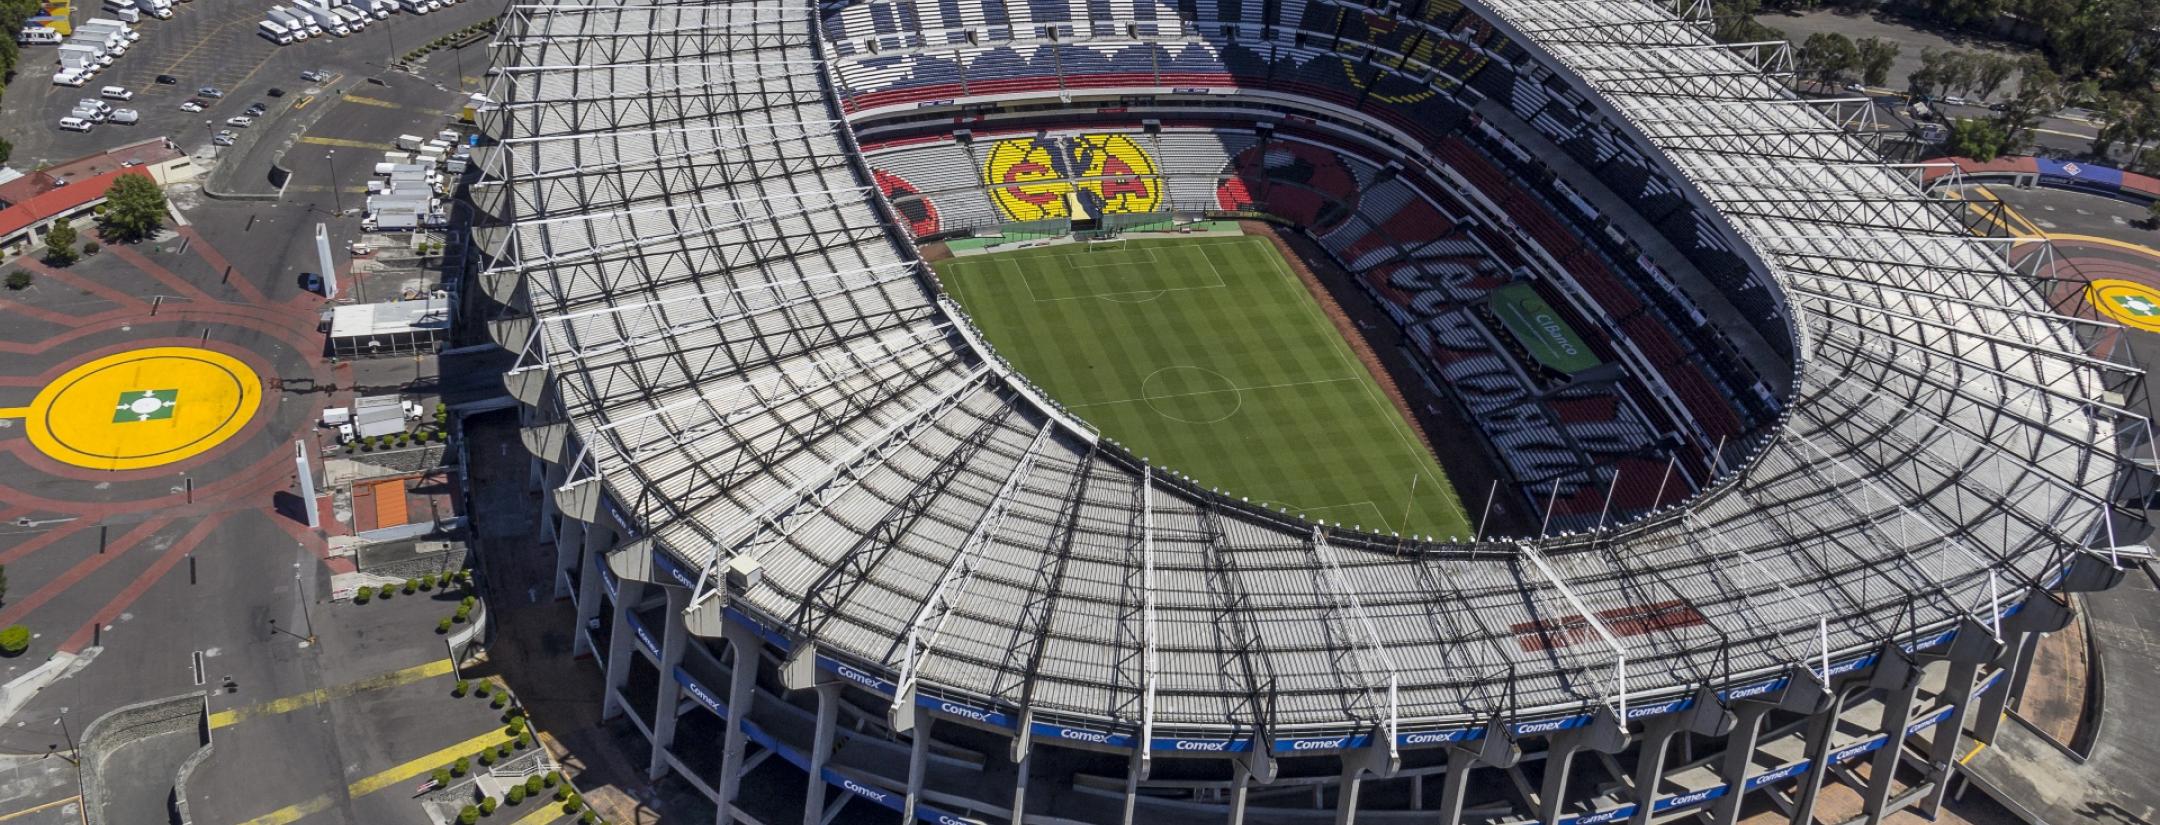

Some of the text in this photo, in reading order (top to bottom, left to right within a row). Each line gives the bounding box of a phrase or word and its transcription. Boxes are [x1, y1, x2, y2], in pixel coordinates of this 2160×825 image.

[838, 666, 883, 689] Comex
[690, 683, 720, 710] Comex
[1729, 683, 1771, 700] Comex
[941, 703, 992, 722] Comex
[1628, 702, 1674, 718] Comex
[1517, 719, 1566, 734] Comex
[1061, 729, 1112, 744] Comex
[1293, 738, 1344, 750] Comex
[1406, 731, 1456, 744] Comex
[1176, 740, 1229, 751] Comex
[1836, 742, 1873, 760] Comex
[1756, 766, 1793, 785] Comex
[843, 780, 887, 802] Comex
[1670, 789, 1712, 806] Comex
[1576, 810, 1618, 825] Comex
